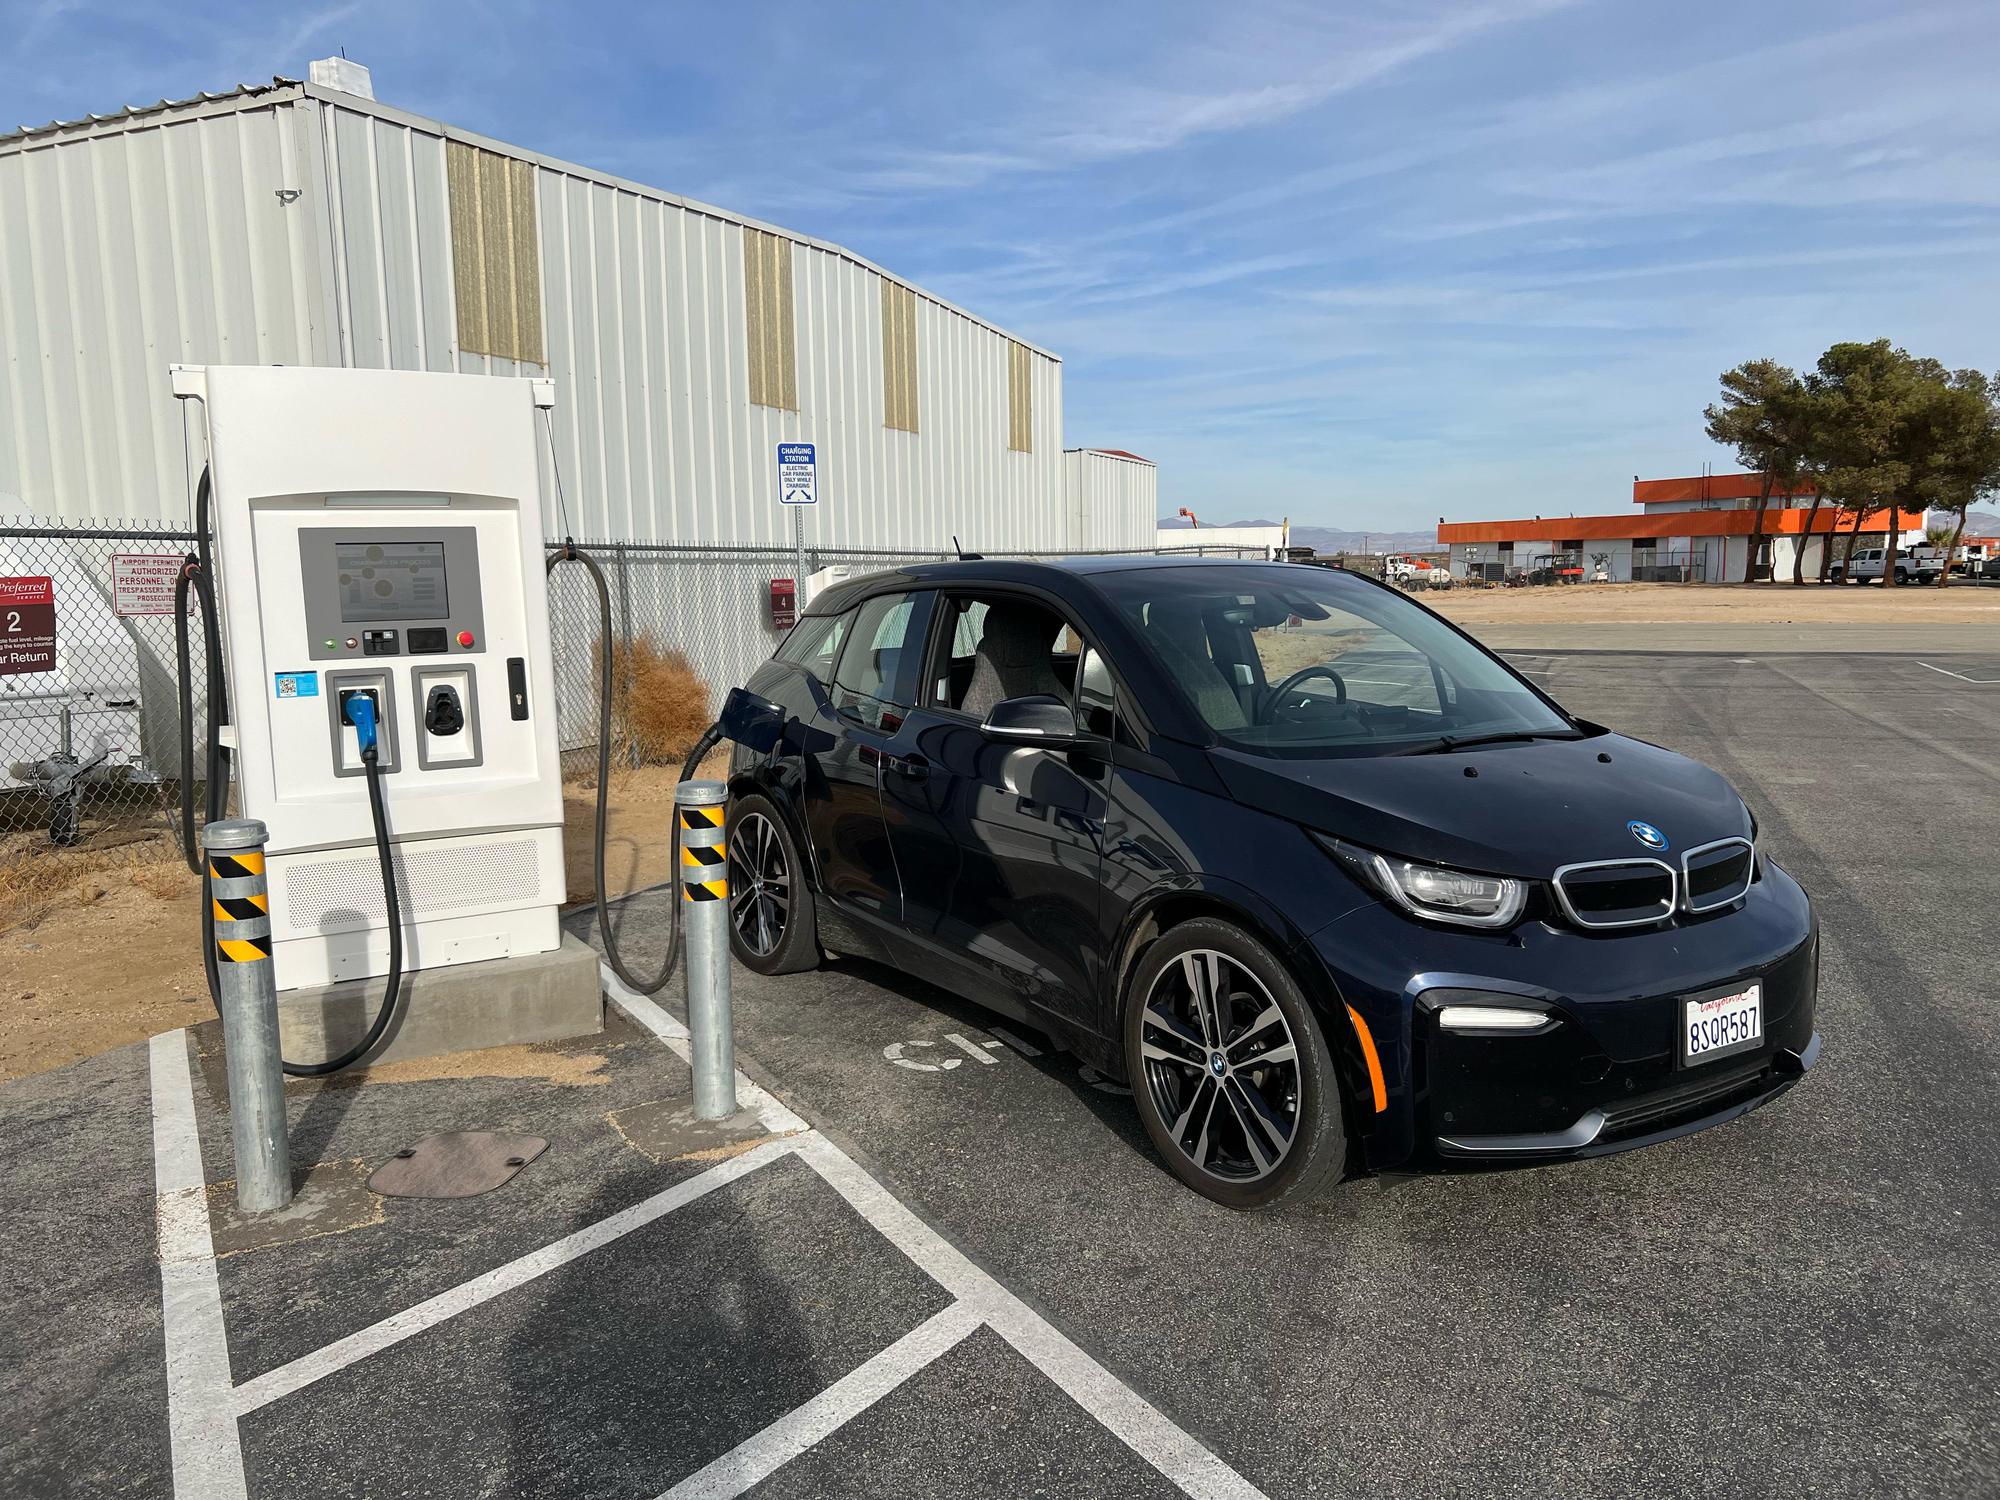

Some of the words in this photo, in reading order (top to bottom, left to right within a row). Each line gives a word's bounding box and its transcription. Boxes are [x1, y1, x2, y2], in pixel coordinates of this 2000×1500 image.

[131, 567, 178, 576] AUTHORIZED
[120, 577, 165, 585] PERSONNEL
[781, 596, 786, 608] 4
[7, 611, 22, 632] 2
[10, 652, 49, 664] Return
[1690, 1006, 1757, 1053] 8SQR587
